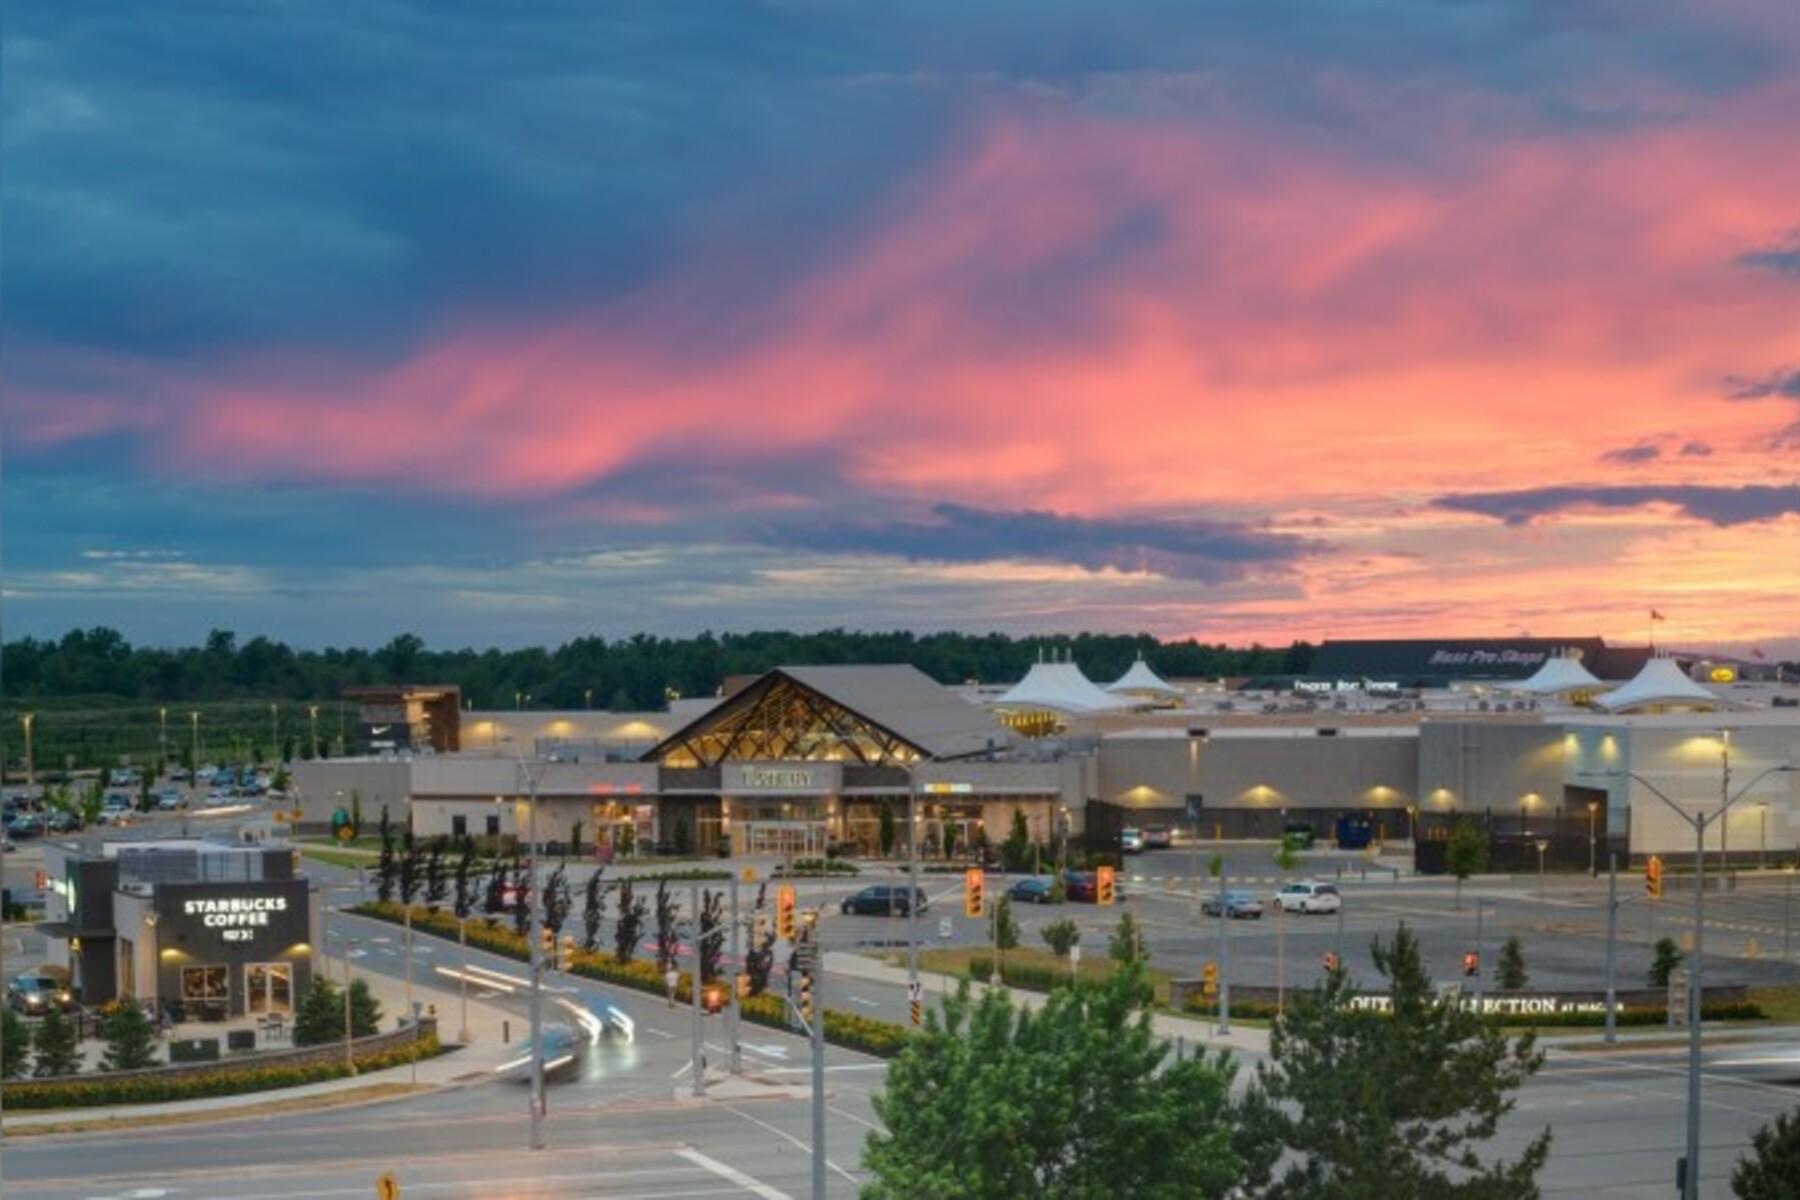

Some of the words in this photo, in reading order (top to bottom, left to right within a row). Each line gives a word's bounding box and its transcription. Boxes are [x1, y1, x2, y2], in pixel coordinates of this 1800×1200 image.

[185, 898, 286, 914] STARBUCKS
[204, 912, 268, 926] COFFEE
[1432, 998, 1556, 1014] LLECTION
